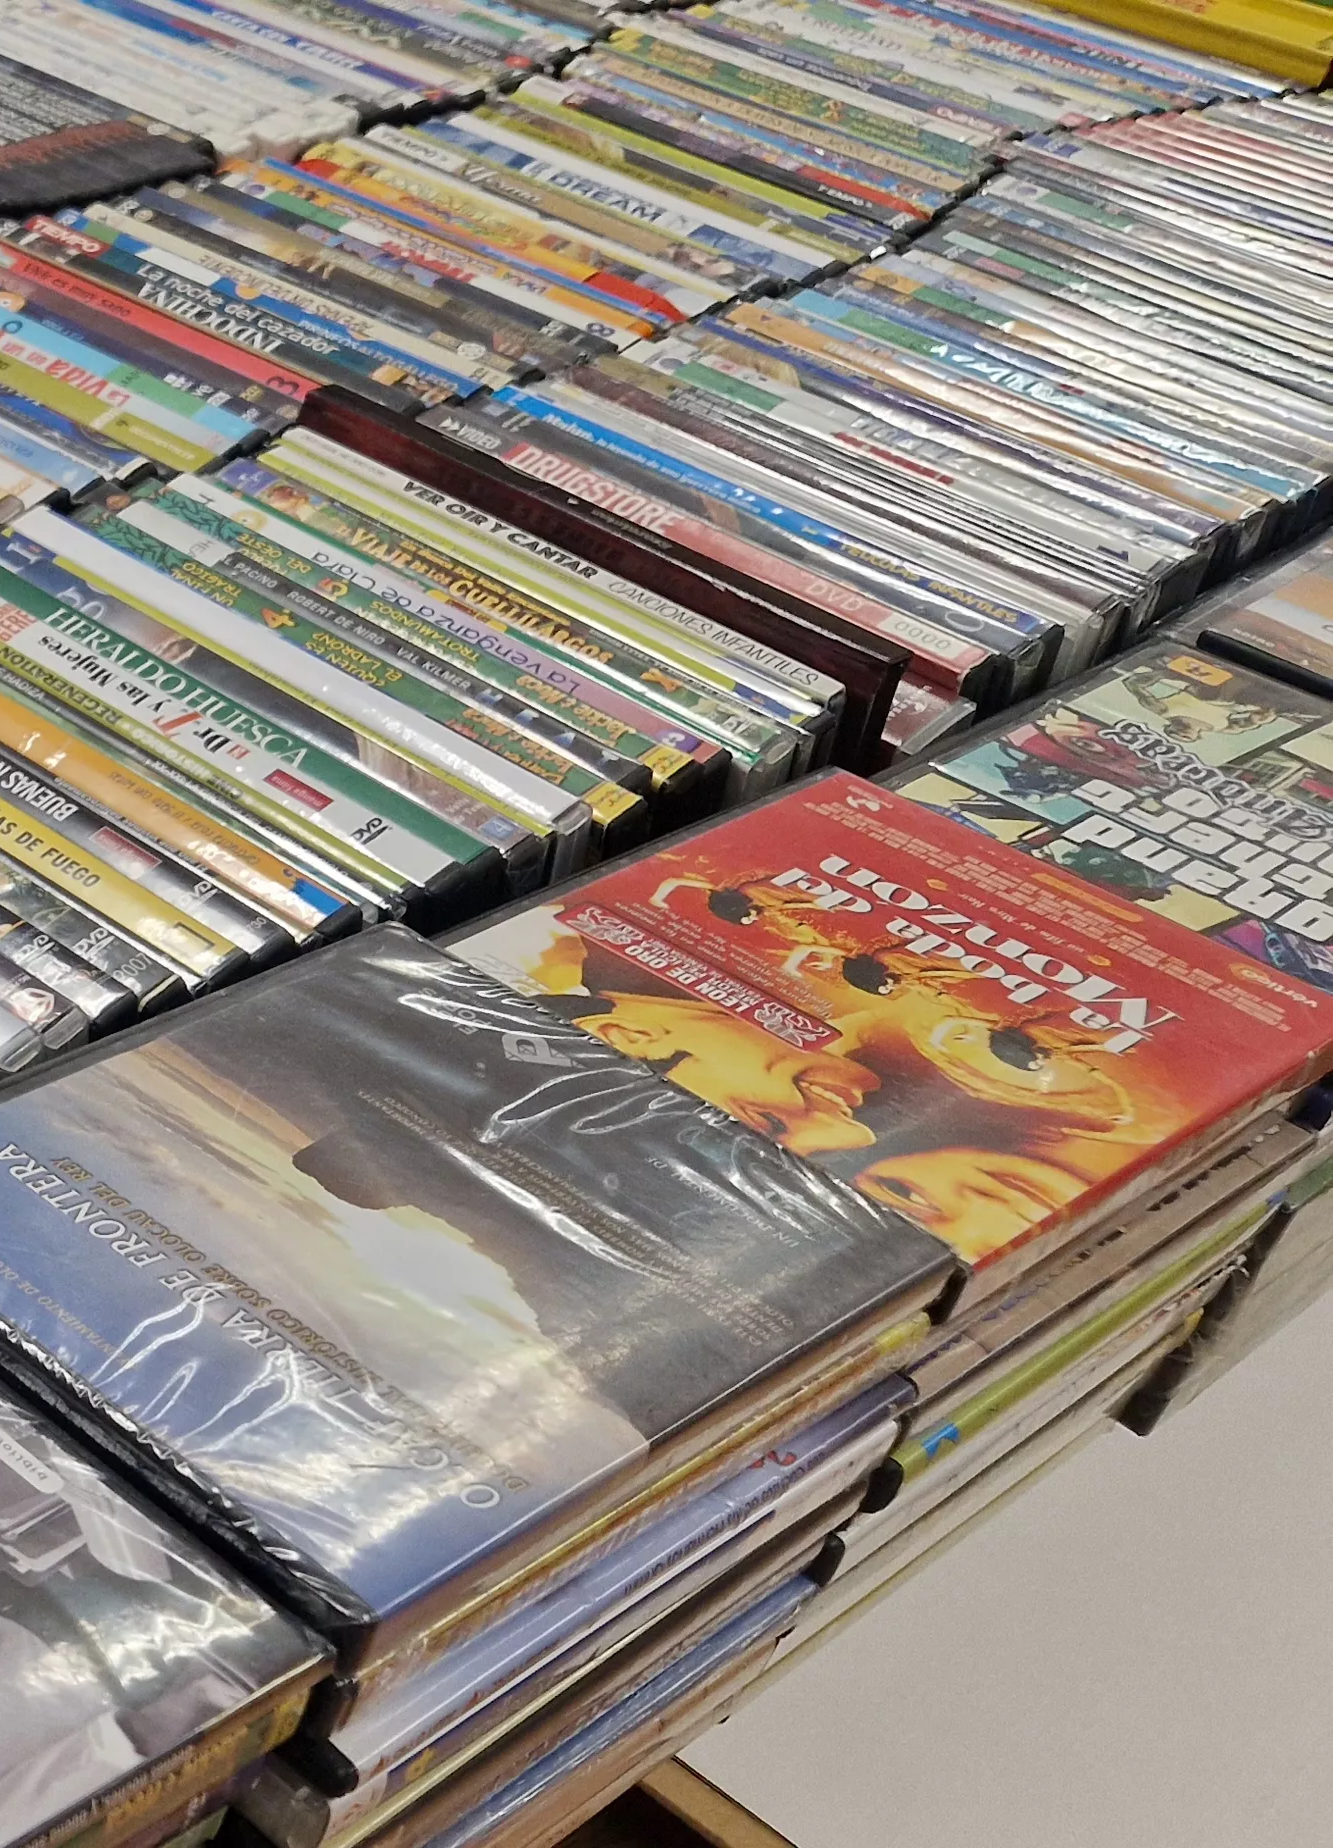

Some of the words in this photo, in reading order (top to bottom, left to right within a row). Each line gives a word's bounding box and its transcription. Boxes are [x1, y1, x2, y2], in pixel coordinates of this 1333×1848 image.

[132, 265, 164, 281] La
[160, 276, 208, 302] noche
[205, 295, 236, 313] del
[232, 308, 337, 360] cazador
[135, 284, 281, 352] INDOCHINA
[401, 481, 447, 506] VER
[450, 503, 490, 527] OIR
[505, 530, 600, 580] CANTAR
[503, 461, 662, 537] DRUGSTORE
[45, 608, 184, 696] HERALDO
[183, 692, 308, 769] HUESCA
[5, 767, 78, 819] BUENAS
[15, 831, 44, 851] DE
[41, 847, 100, 883] FUEGO
[769, 866, 873, 916] del
[886, 916, 1050, 1007] boda
[1068, 1003, 1154, 1057] La
